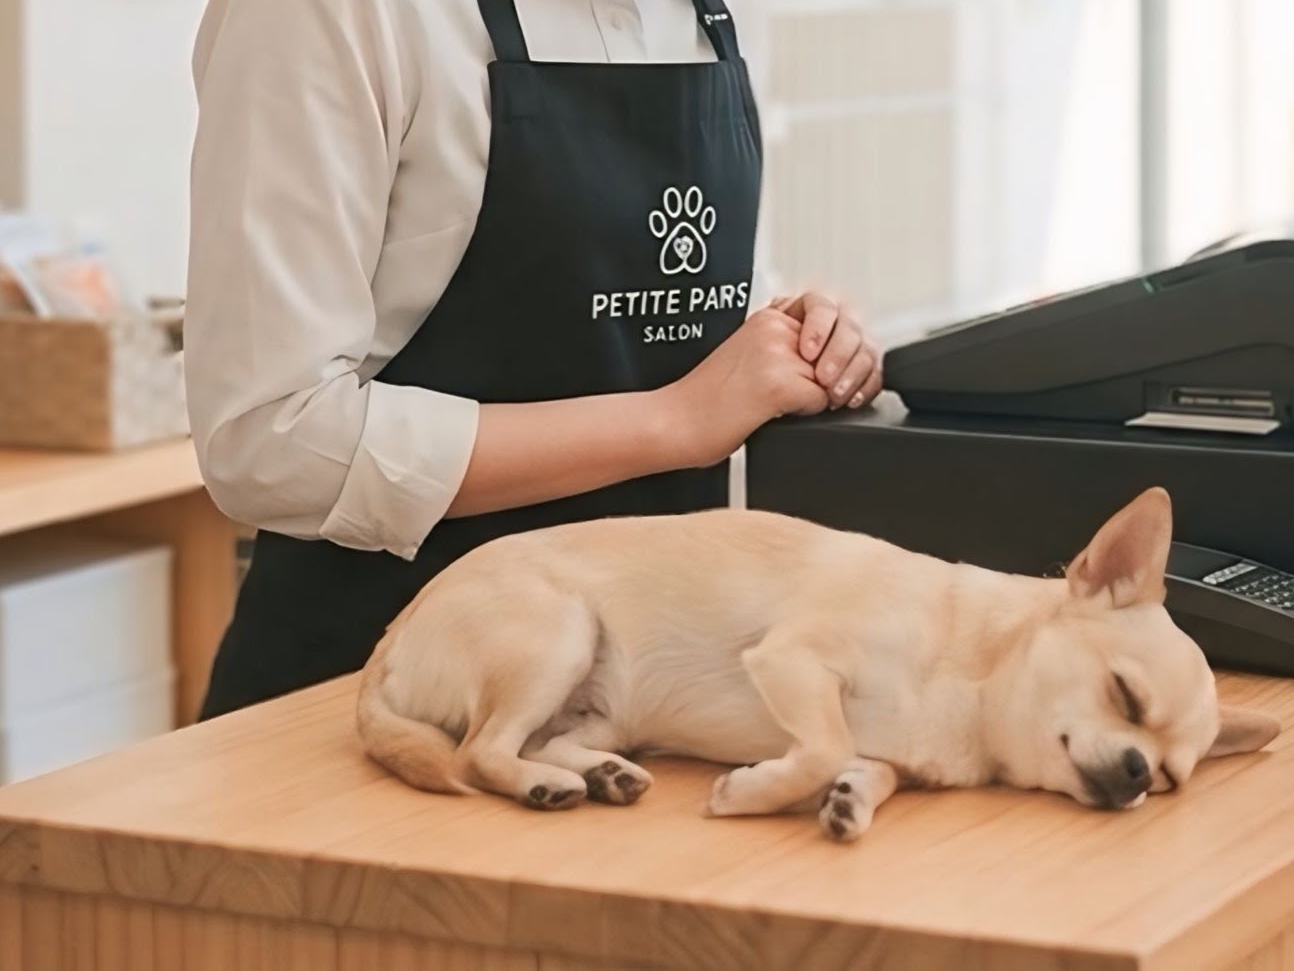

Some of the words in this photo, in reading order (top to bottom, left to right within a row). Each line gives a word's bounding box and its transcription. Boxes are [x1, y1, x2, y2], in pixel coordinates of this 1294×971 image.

[591, 289, 681, 319] PETITE
[688, 282, 749, 313] PARS
[643, 323, 703, 343] SALON
